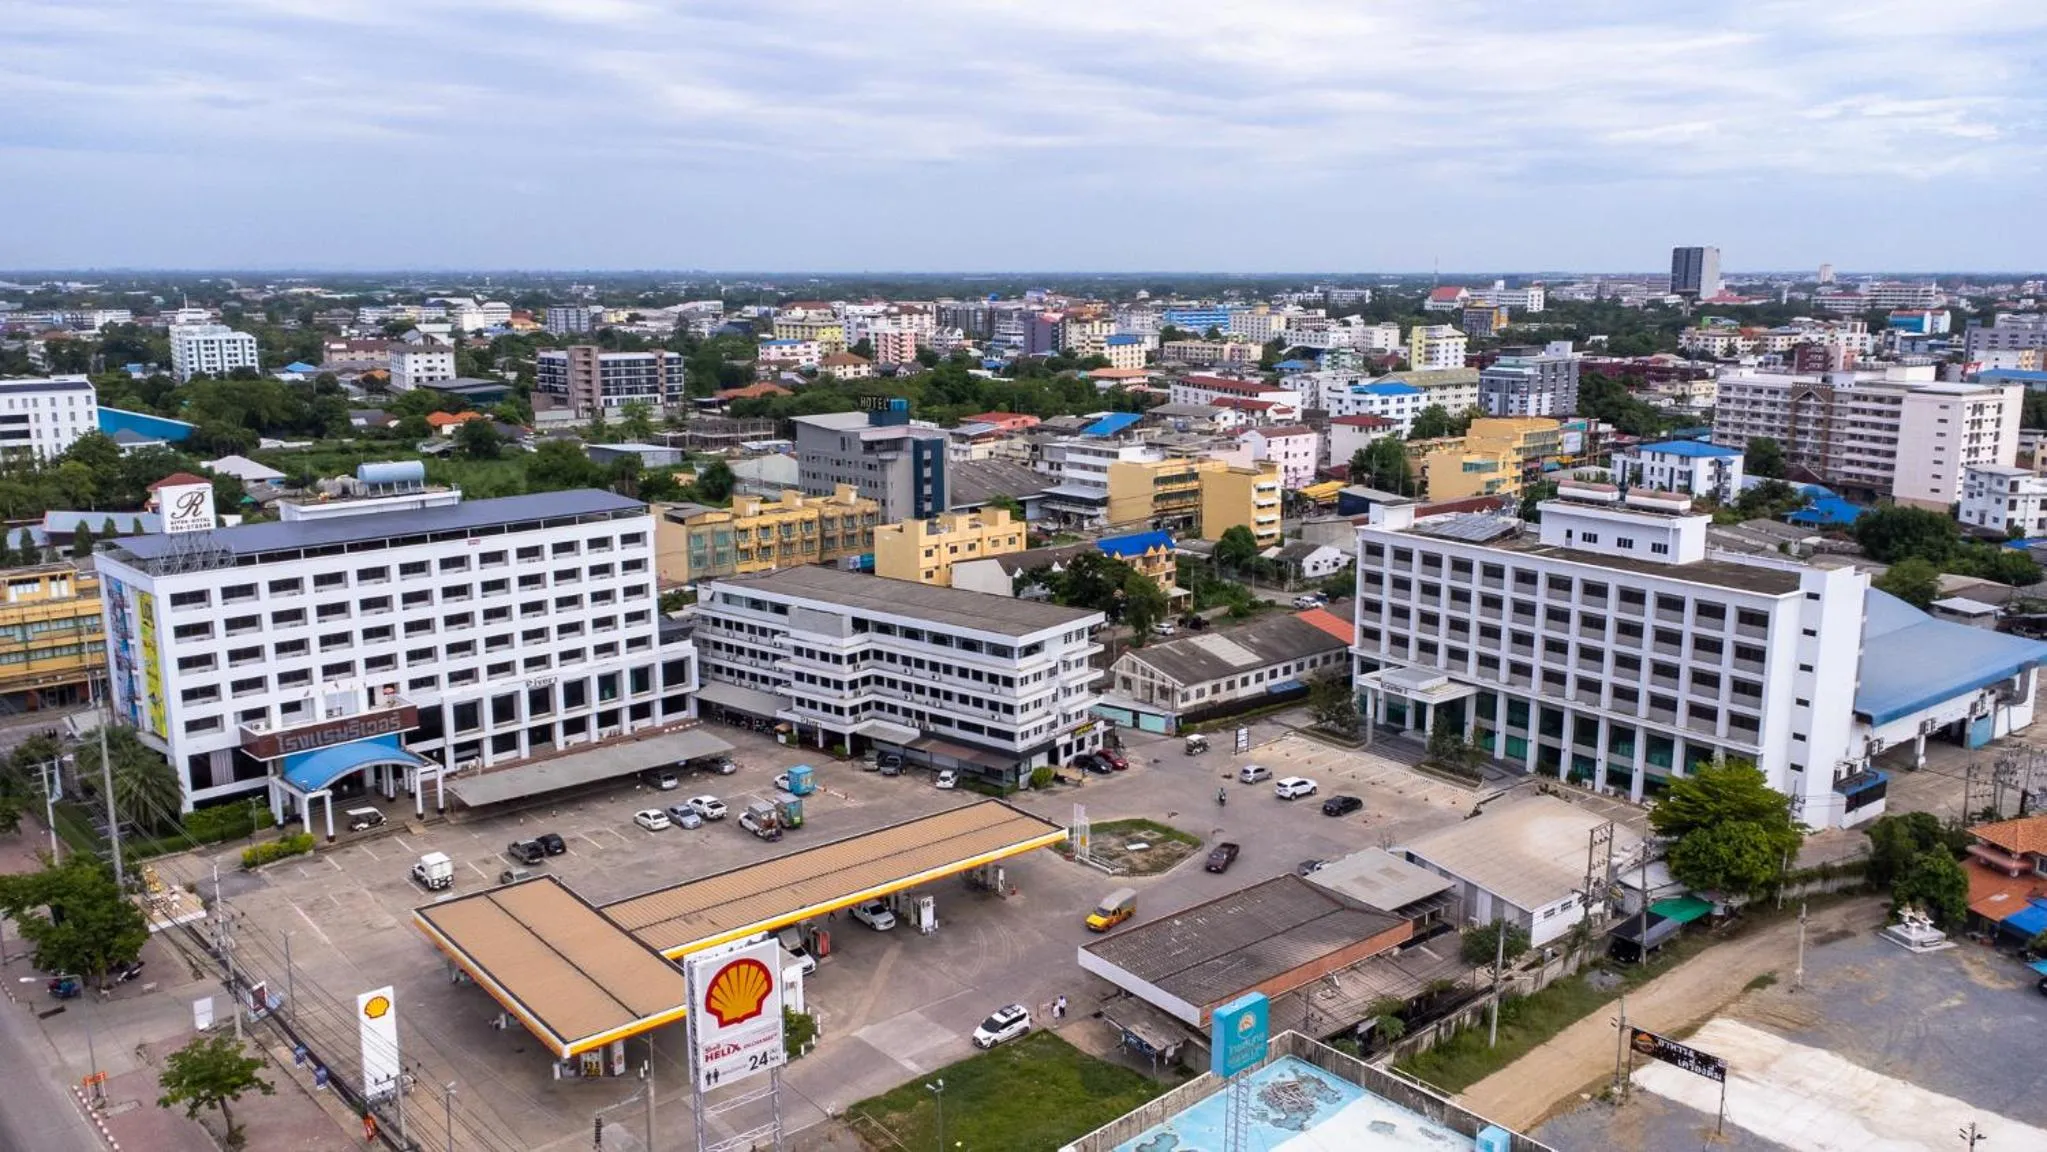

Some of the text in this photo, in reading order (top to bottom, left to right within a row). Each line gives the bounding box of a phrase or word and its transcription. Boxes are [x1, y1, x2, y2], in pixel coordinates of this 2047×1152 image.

[860, 396, 889, 410] HOTEL
[171, 491, 206, 519] R
[704, 1043, 742, 1063] HELIX
[749, 1051, 768, 1070] 24
